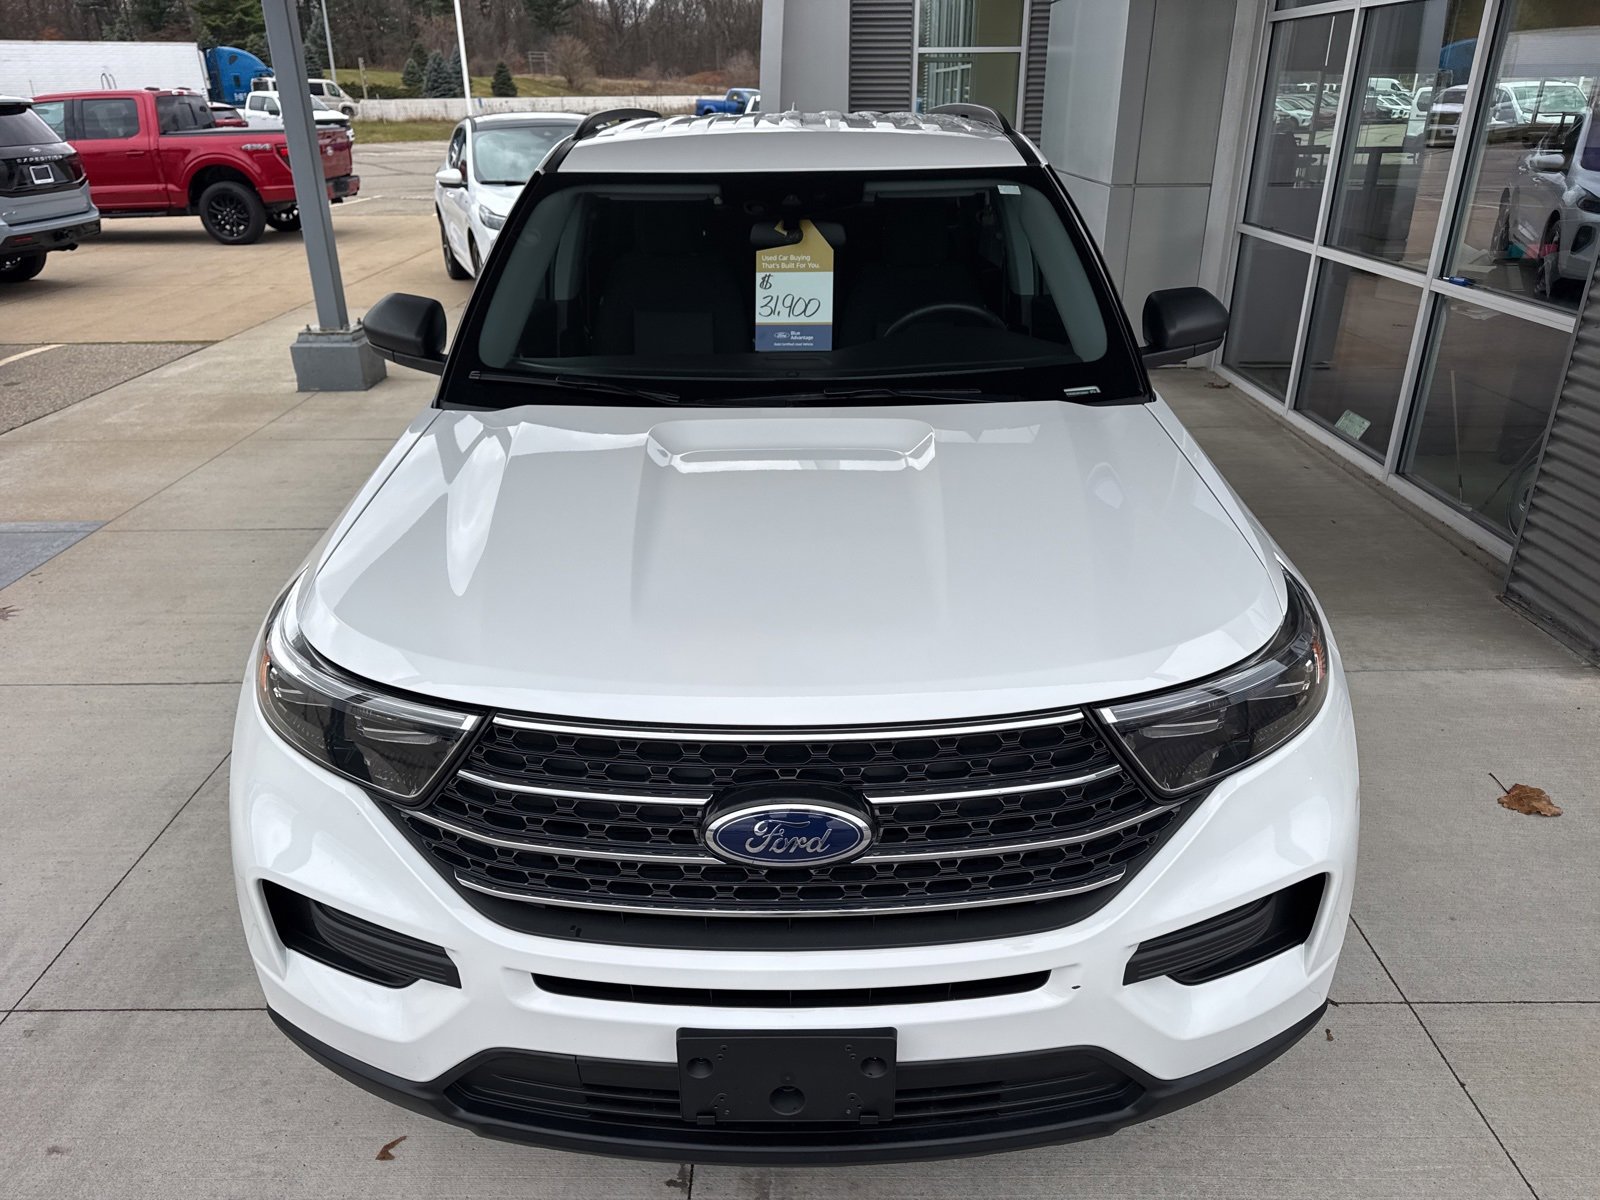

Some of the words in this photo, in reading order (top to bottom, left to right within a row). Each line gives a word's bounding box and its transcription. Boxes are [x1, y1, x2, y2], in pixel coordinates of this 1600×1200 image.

[789, 254, 811, 262] Buying
[759, 273, 773, 290] $
[745, 819, 833, 854] Ford
